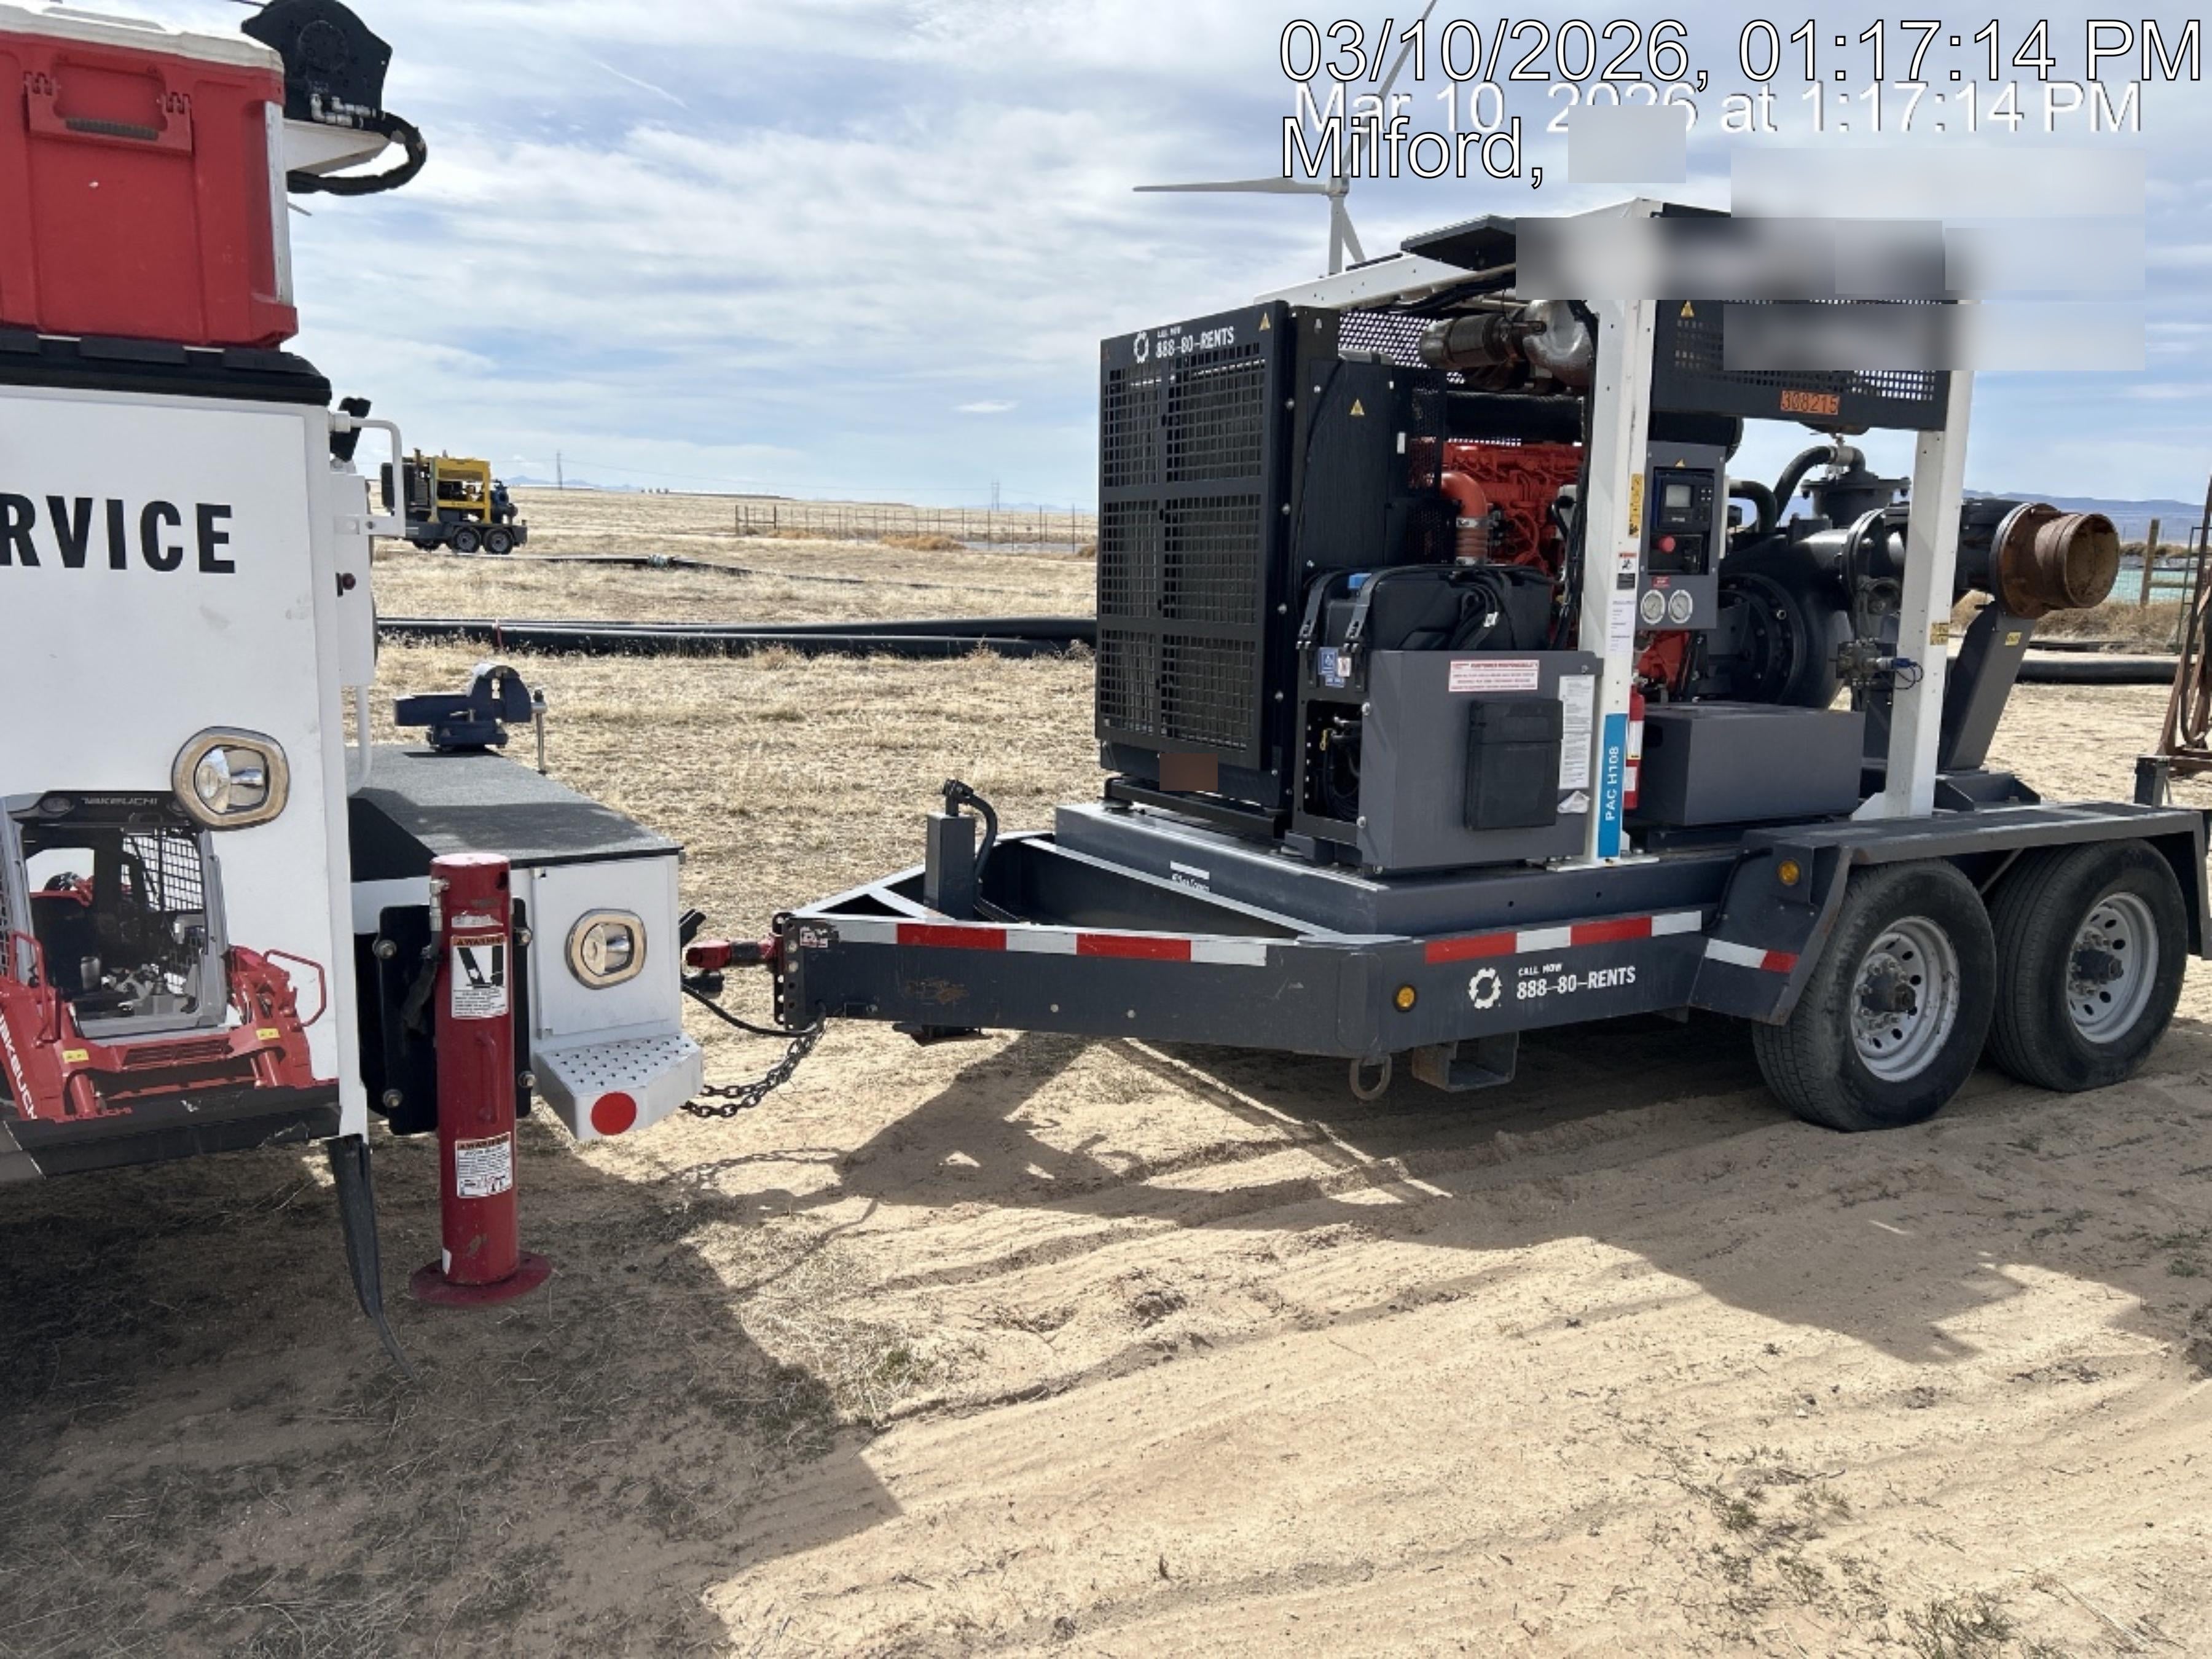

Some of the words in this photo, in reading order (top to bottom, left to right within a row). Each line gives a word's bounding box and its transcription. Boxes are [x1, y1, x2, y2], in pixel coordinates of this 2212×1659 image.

[1605, 788, 1618, 822] PAC
[1516, 965, 1636, 1000] 888-80-RENTS
[1518, 965, 1539, 978] CALL
[1542, 962, 1563, 975] NOW
